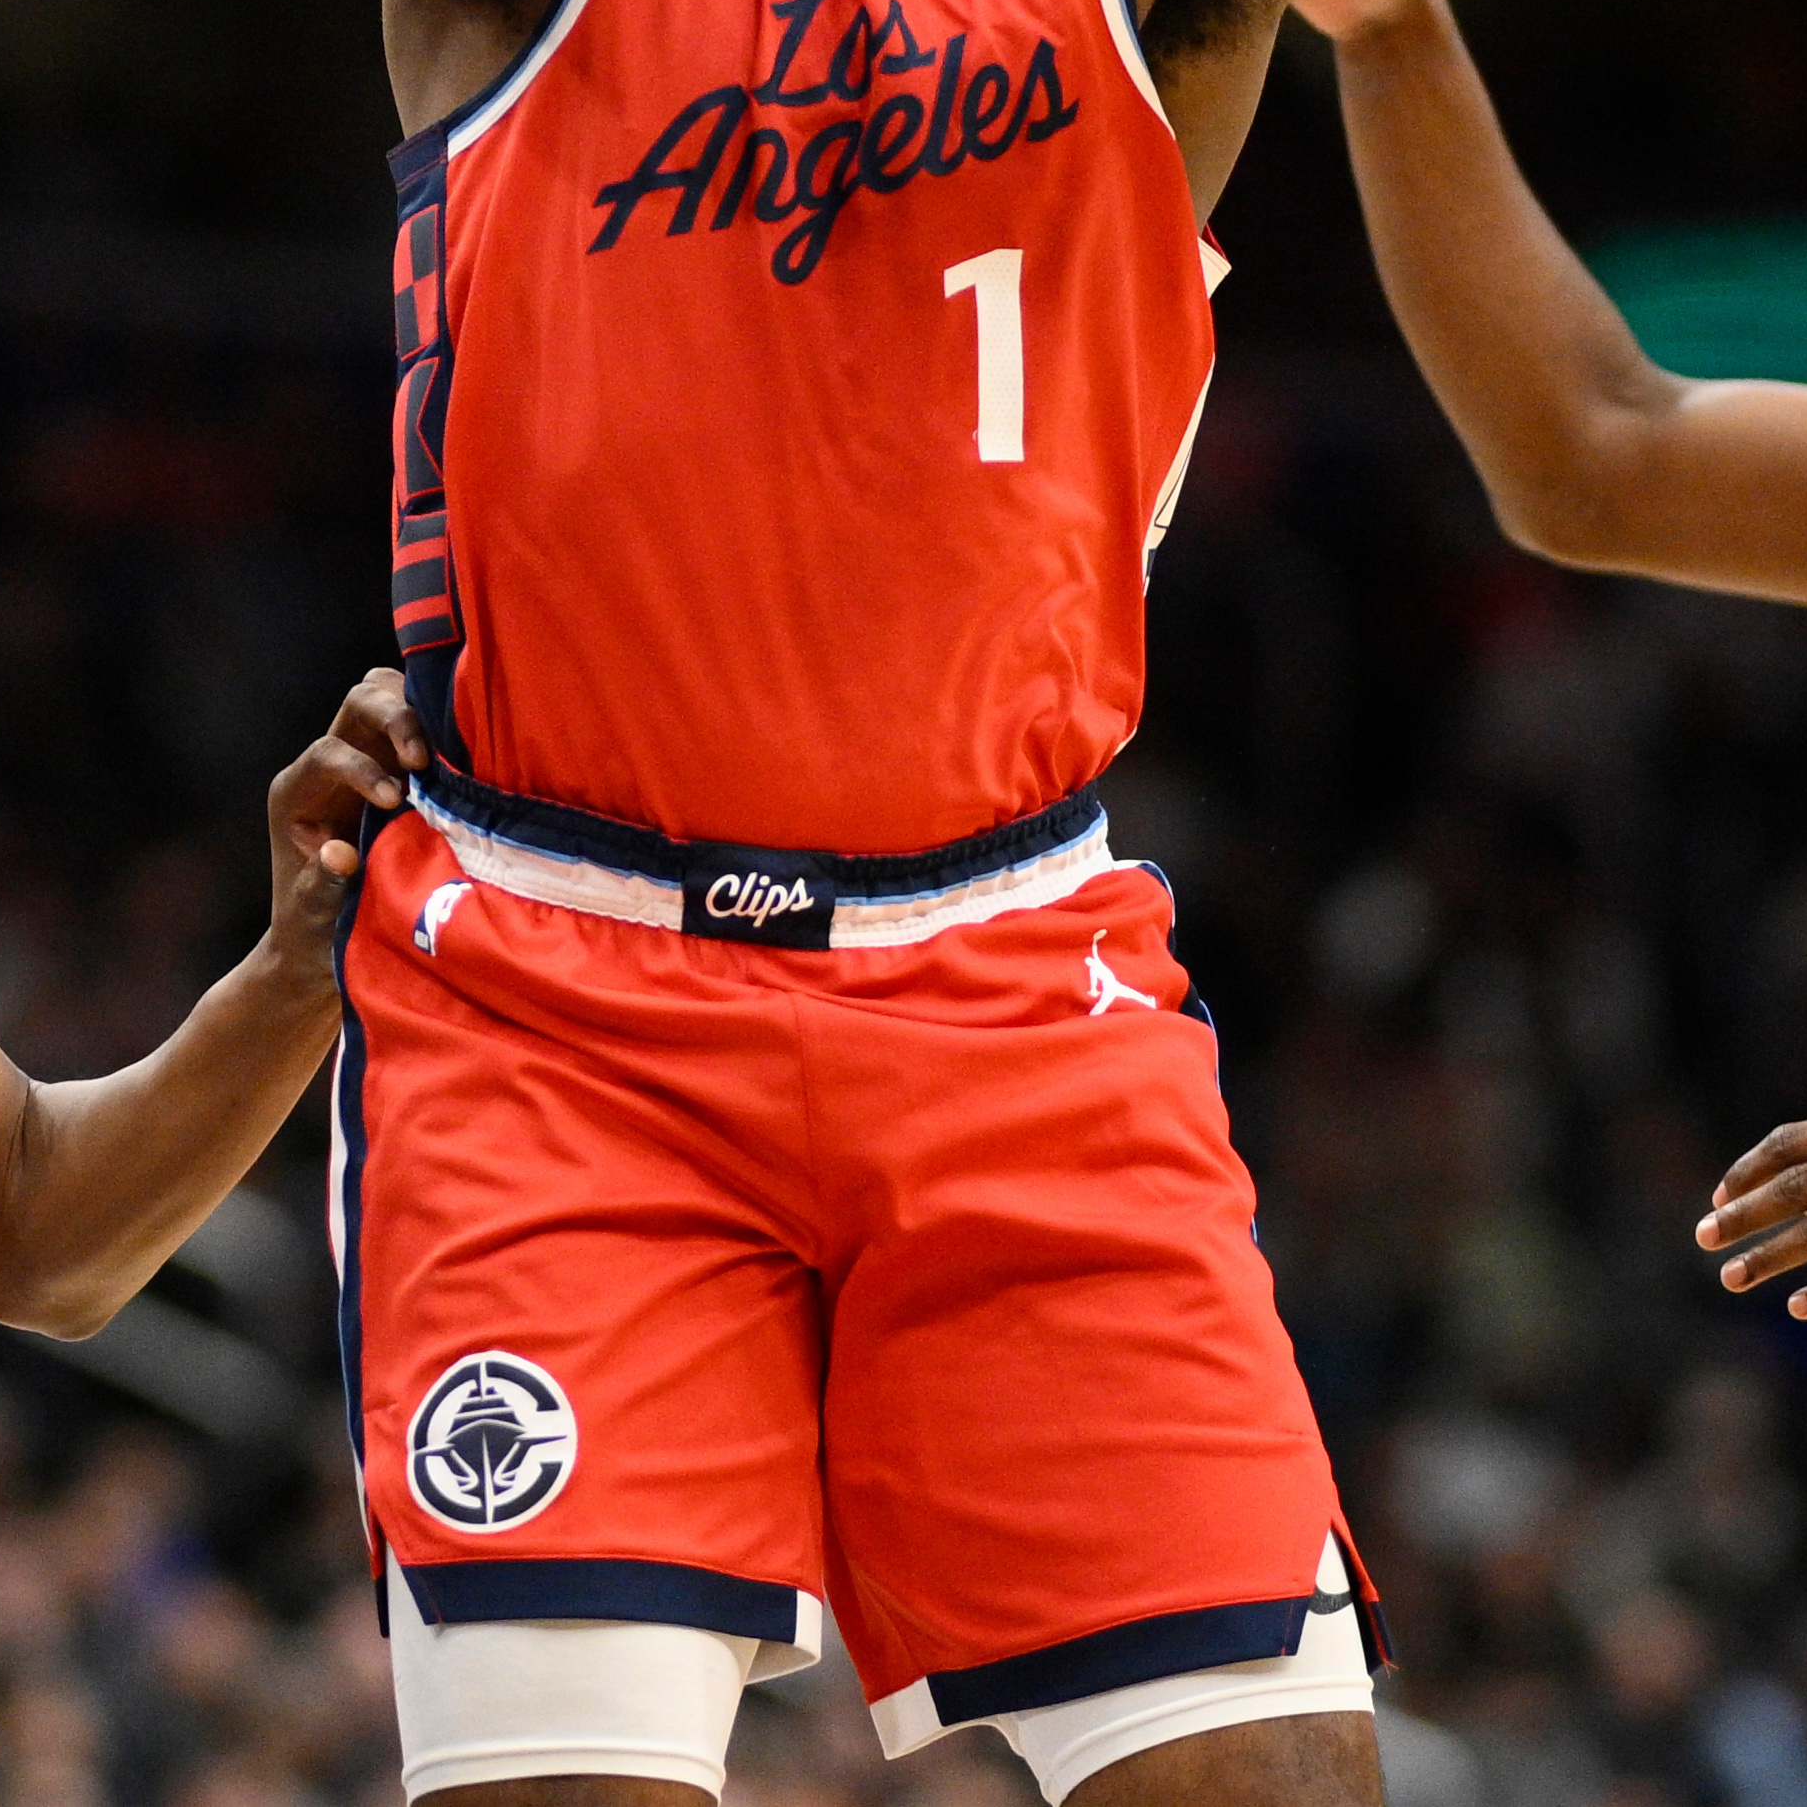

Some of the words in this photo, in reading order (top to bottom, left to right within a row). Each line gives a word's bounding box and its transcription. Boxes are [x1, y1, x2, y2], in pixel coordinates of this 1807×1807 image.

[586, 37, 1080, 286] Angeles
[943, 247, 1025, 464] 1
[705, 871, 816, 929] Clips
